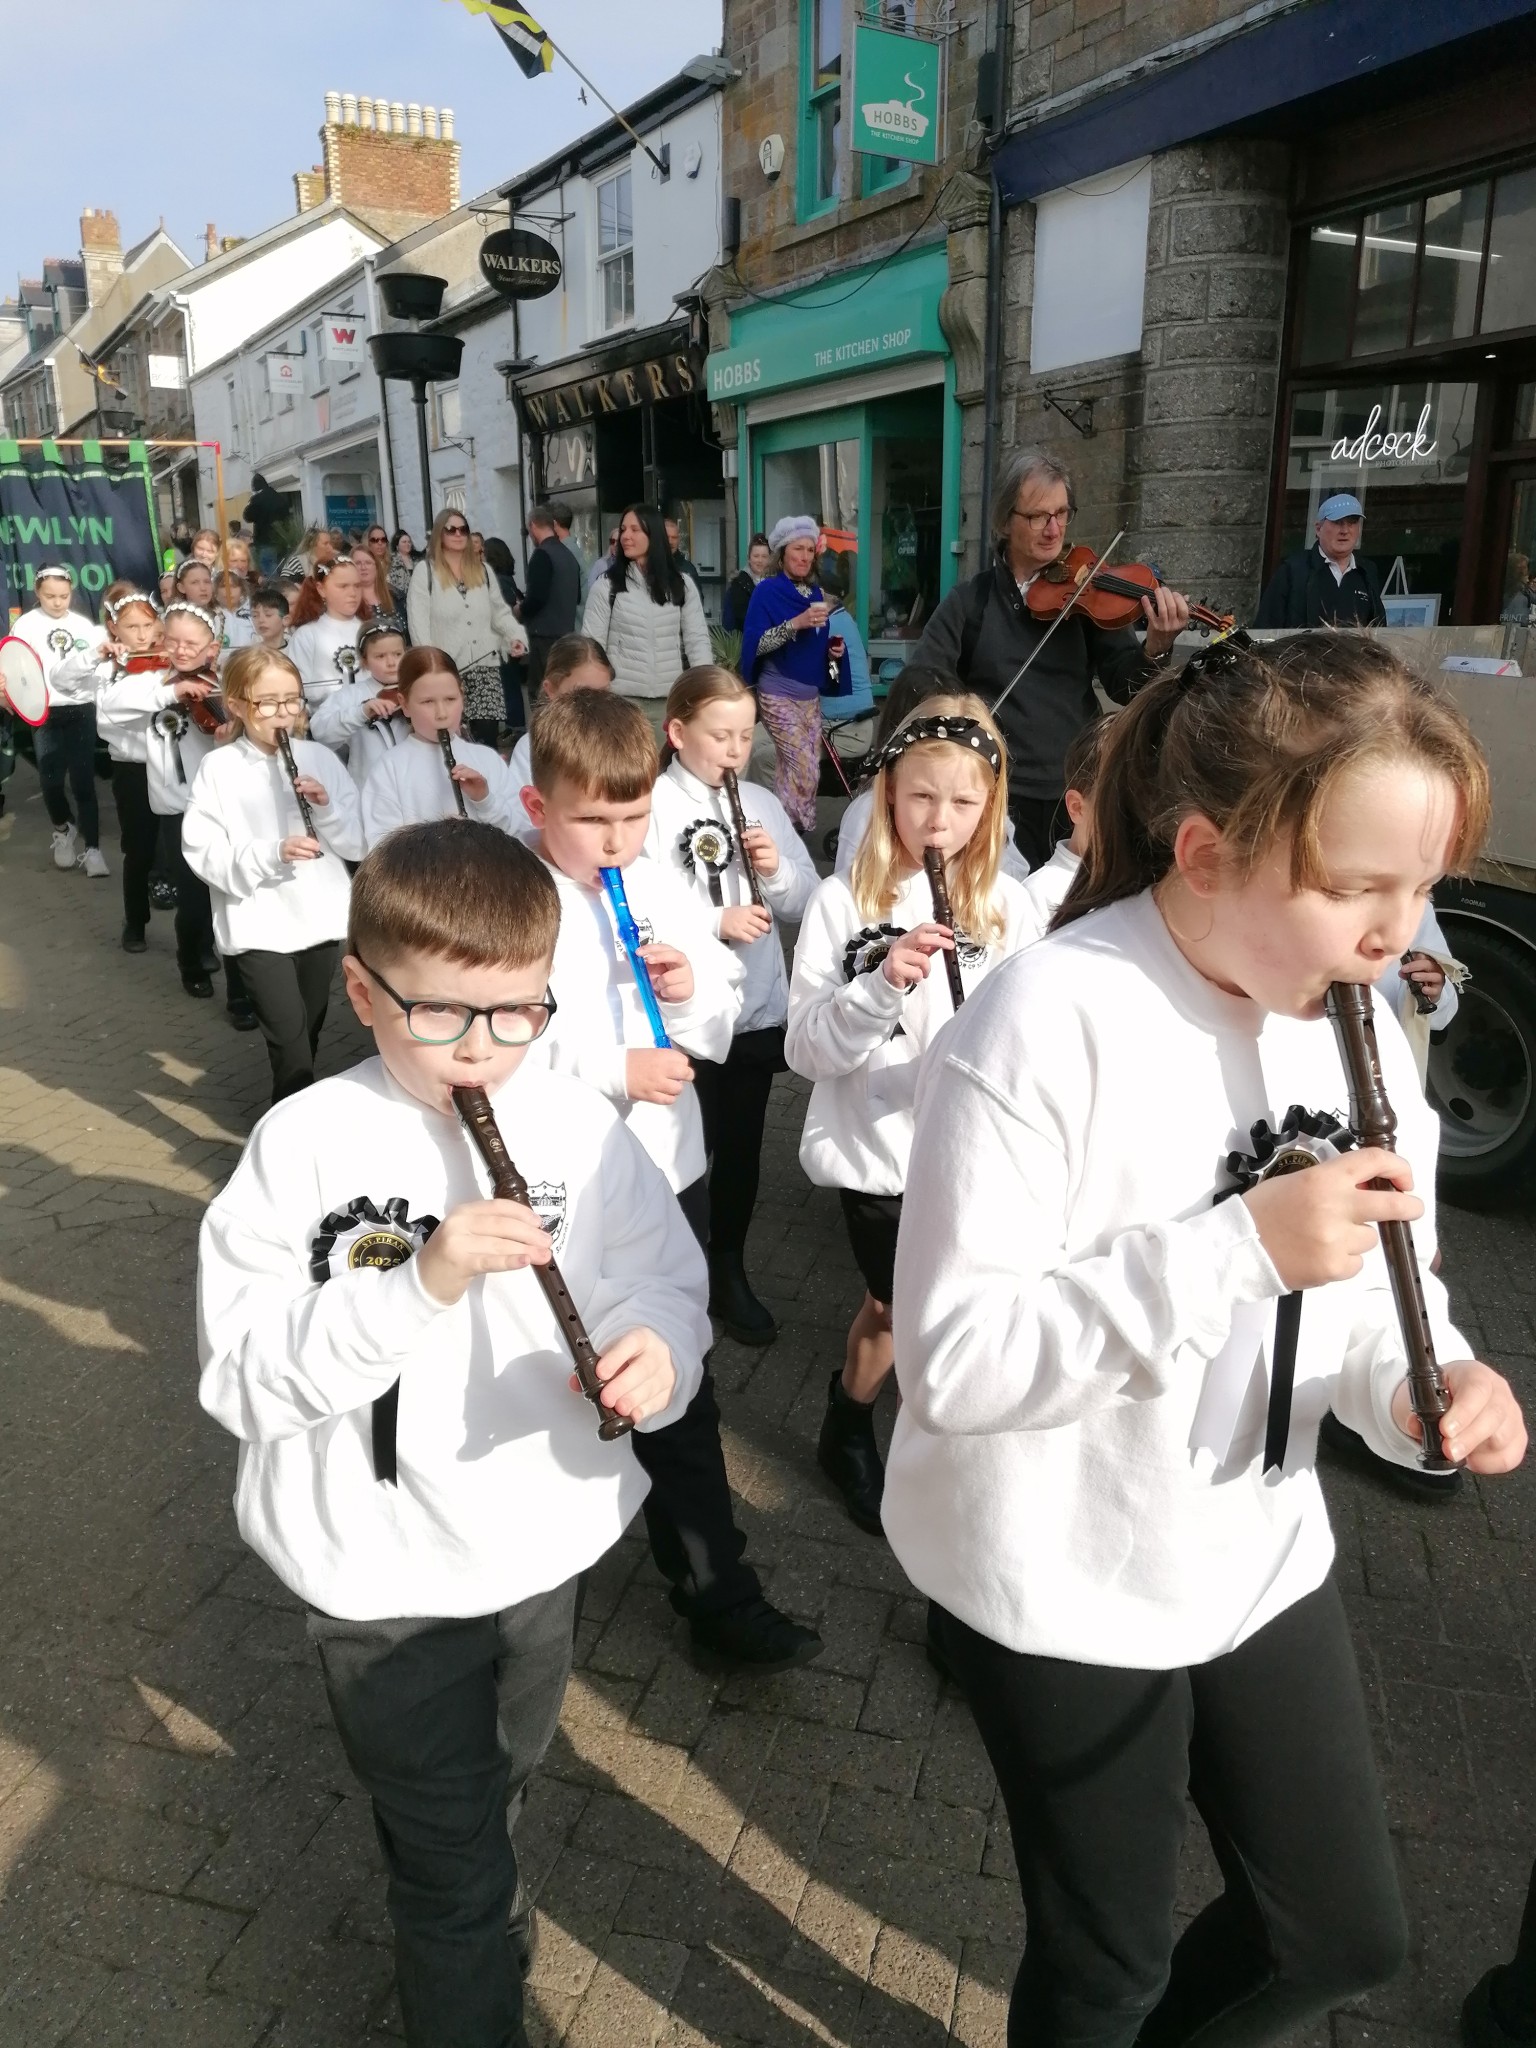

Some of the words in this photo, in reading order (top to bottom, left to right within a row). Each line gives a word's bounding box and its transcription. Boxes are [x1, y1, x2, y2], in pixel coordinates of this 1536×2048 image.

[874, 110, 917, 131] HOBBS
[871, 130, 881, 138] THE
[882, 132, 904, 142] KITCHEN
[905, 137, 920, 145] SHOP
[482, 253, 561, 275] WALKERS
[814, 352, 833, 367] THE
[835, 337, 879, 362] KITCHEN
[882, 328, 911, 350] SHOP
[713, 358, 761, 392] HOBBS
[528, 355, 693, 427] WALKERS
[1331, 404, 1437, 468] adcock
[366, 1256, 401, 1267] 2025
